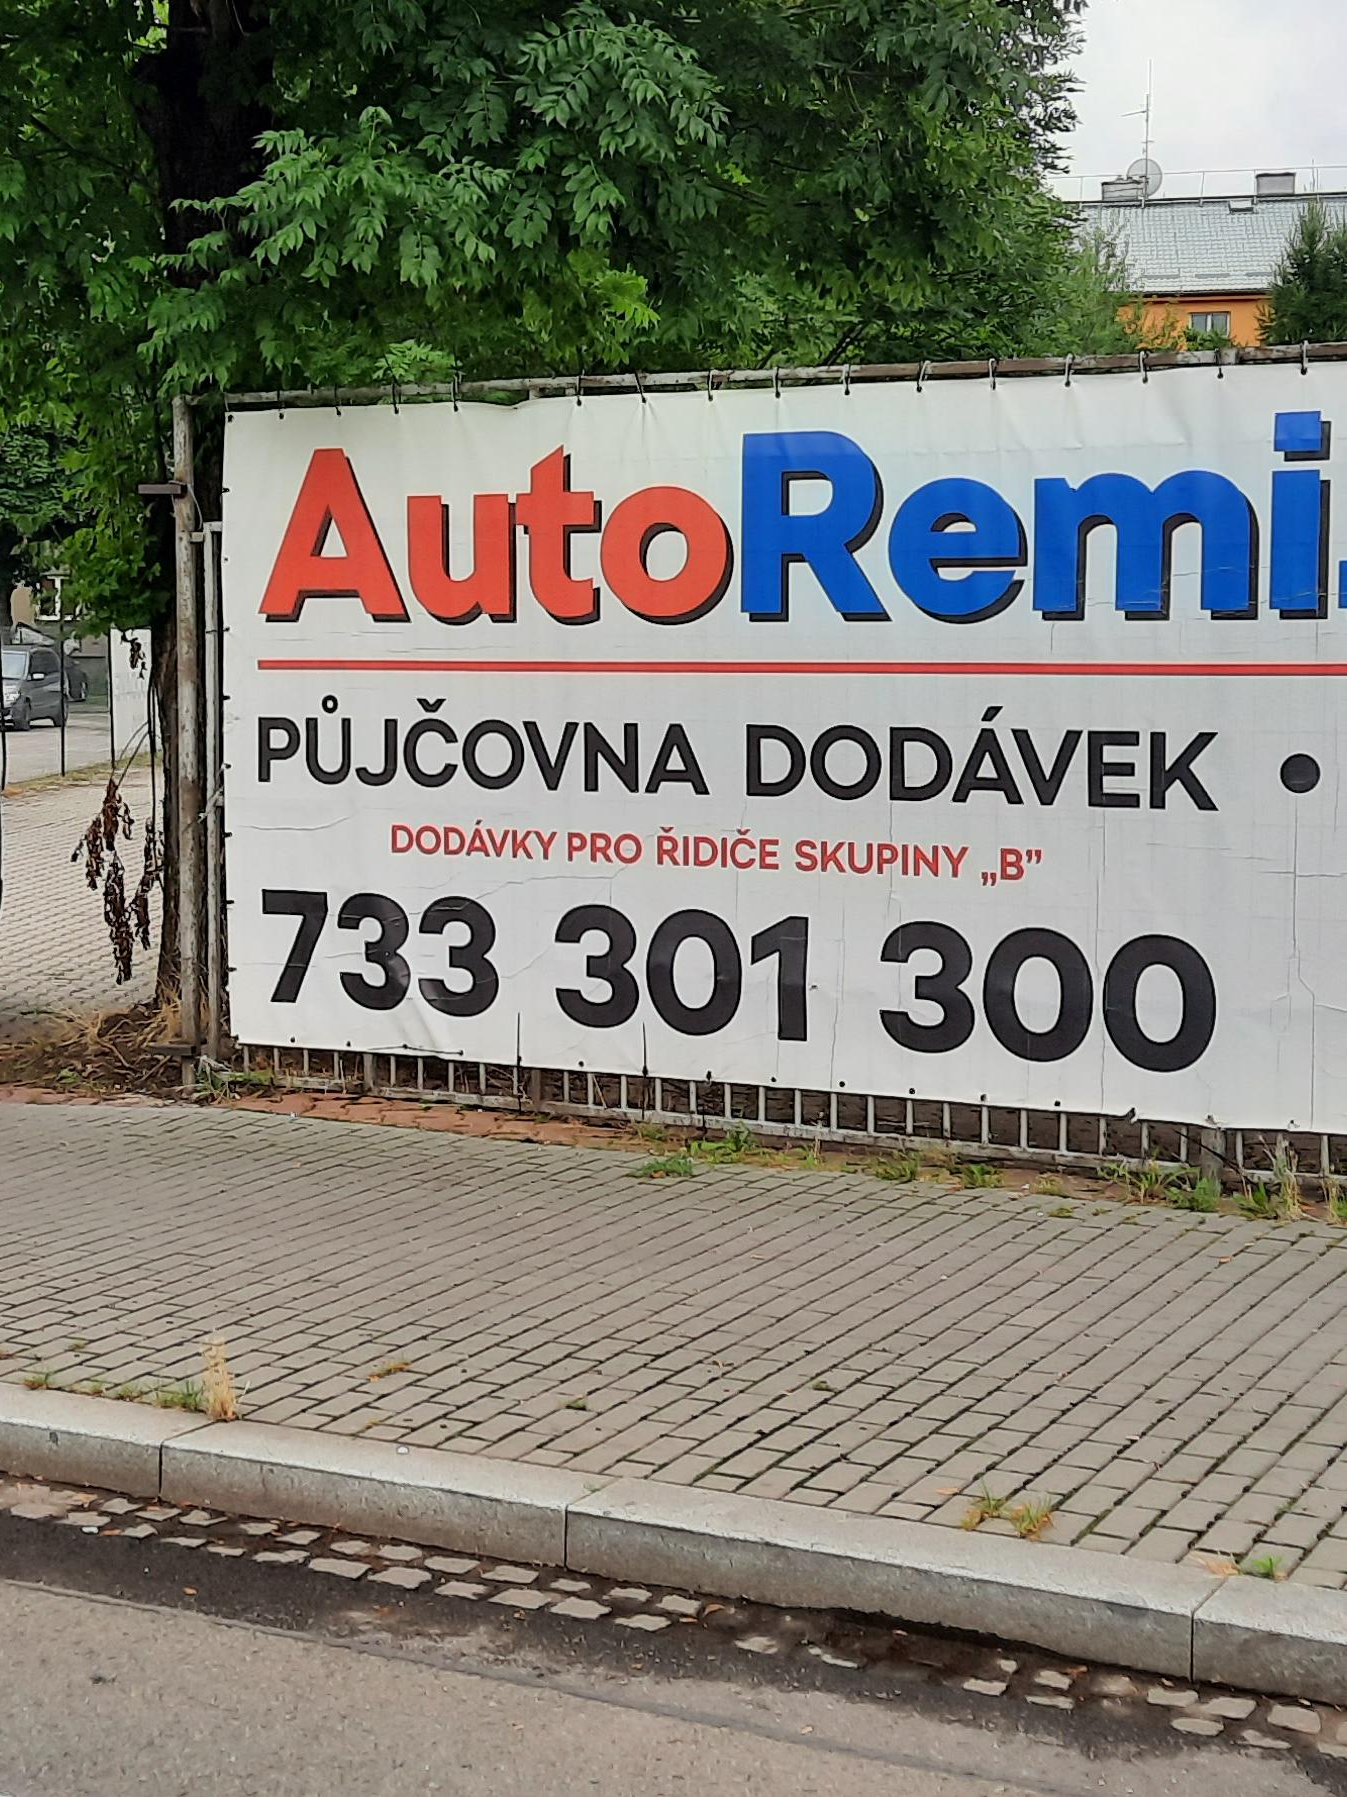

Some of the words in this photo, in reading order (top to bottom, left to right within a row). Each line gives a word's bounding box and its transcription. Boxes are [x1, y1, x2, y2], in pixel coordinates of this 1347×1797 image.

[258, 410, 1347, 626] AutoRemi
[257, 695, 710, 795] PŮJČOVNA
[746, 706, 1220, 811] DODÁVEK
[390, 819, 557, 861] DODÁVKY
[566, 832, 642, 865] PRO
[656, 826, 780, 870] ŘIDIČE
[795, 840, 969, 878] SKUPINY
[261, 889, 500, 1018] 733
[554, 903, 809, 1041] 301
[879, 921, 1217, 1073] 300
